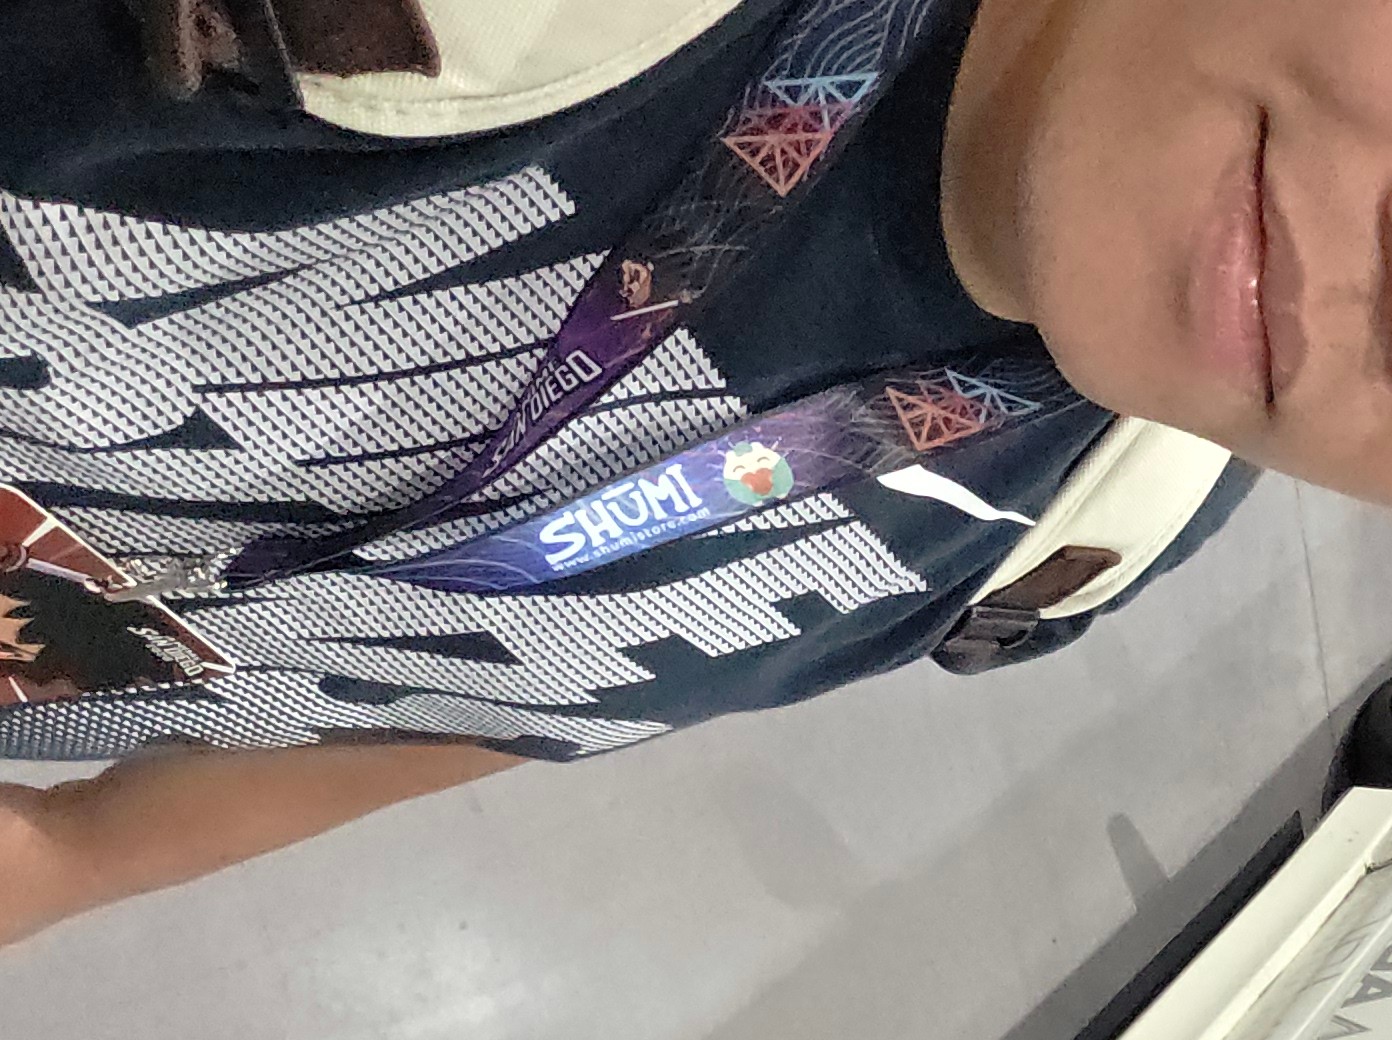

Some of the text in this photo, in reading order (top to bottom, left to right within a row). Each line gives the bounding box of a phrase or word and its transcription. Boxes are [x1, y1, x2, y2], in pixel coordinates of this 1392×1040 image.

[530, 350, 603, 420] DIEGO
[539, 464, 702, 565] SHUMI
[552, 507, 710, 571] www.shumistore.com
